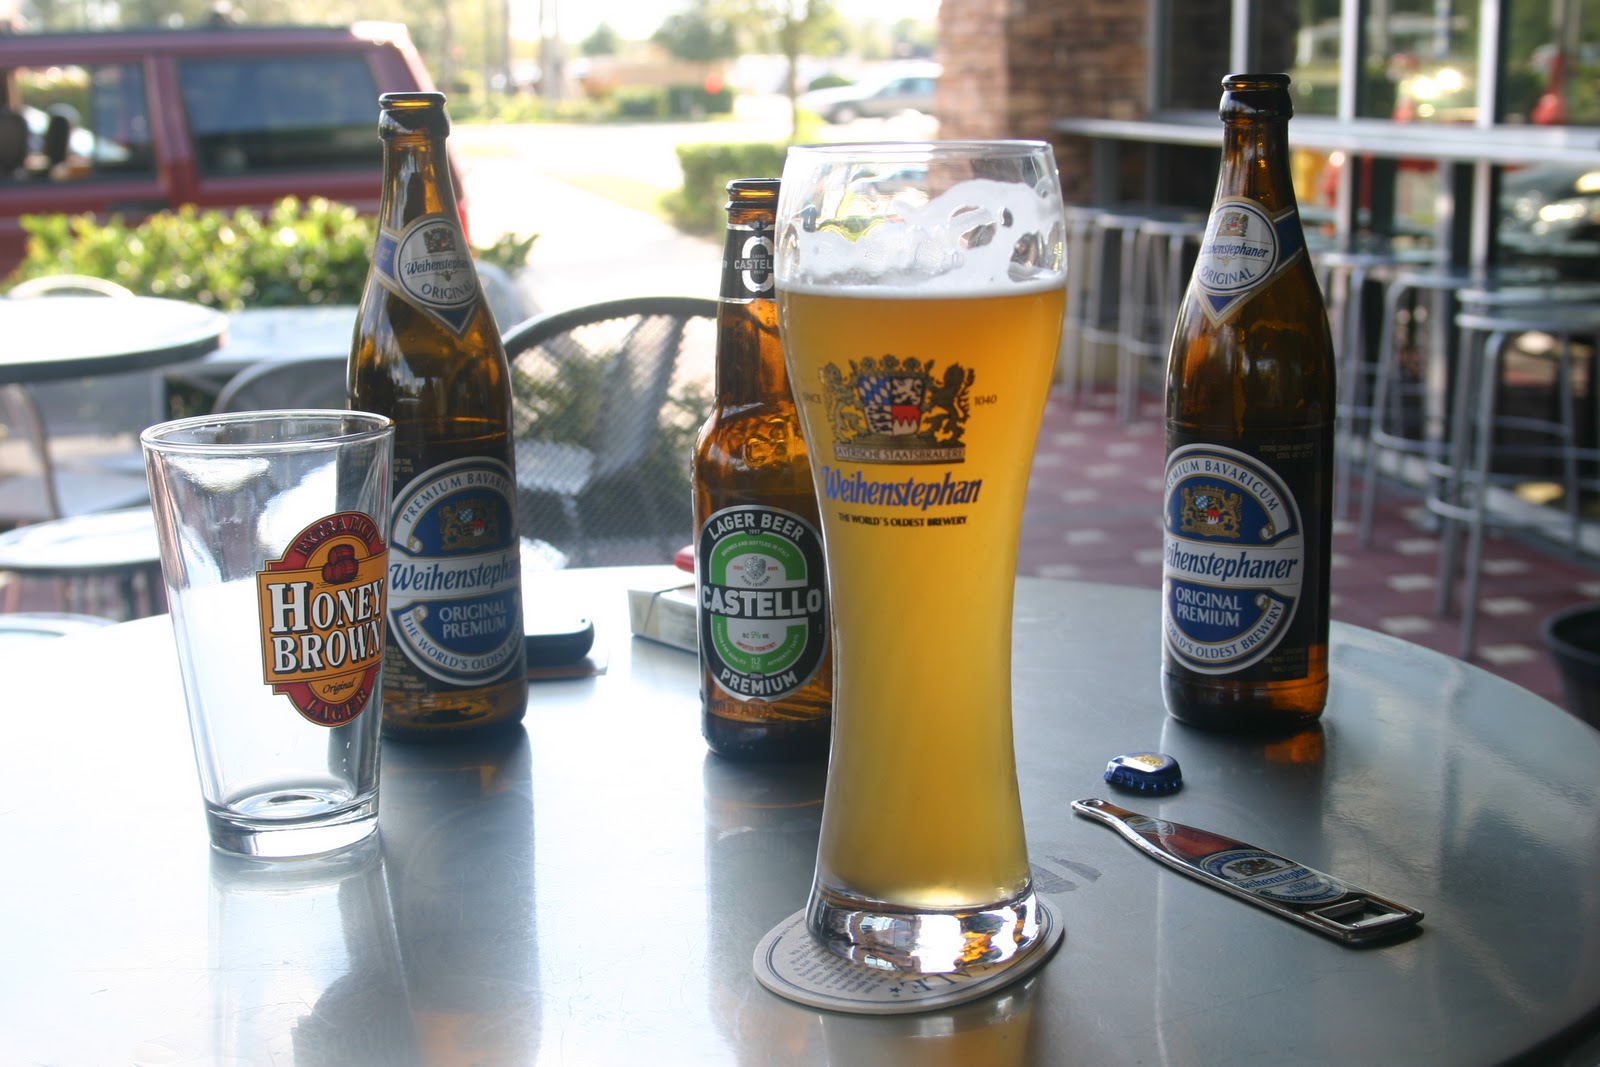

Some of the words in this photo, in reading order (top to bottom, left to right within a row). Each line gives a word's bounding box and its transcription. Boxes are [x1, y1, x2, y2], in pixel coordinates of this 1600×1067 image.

[734, 259, 773, 270] CASTEL
[1201, 265, 1256, 285] ORIGINAL
[421, 280, 474, 300] ORIGINAL
[402, 475, 463, 524] PREMIUM
[821, 465, 983, 511] Weihenstephan
[1205, 461, 1280, 511] BAVARICUM
[296, 516, 348, 557] EXTRA
[350, 515, 376, 544] RICH
[708, 513, 756, 541] LAGER
[760, 513, 805, 542] BEER
[891, 516, 926, 527] OLDEST
[927, 515, 968, 527] BREWERY
[390, 555, 517, 591] Weihenstepha
[1167, 541, 1298, 582] eihenstephaner
[267, 578, 385, 635] HONEY
[439, 599, 508, 623] ORIGINAL
[701, 585, 823, 618] CASTELLO
[1175, 586, 1243, 611] ORIGINAL
[442, 615, 507, 640] PREMIUM
[1176, 605, 1240, 628] PREMIUM
[1195, 644, 1239, 659] OLDEST
[1241, 604, 1283, 650] BREWERY
[271, 617, 384, 674] BROWN
[402, 615, 419, 638] THE
[418, 635, 469, 671] WORLD'S
[322, 676, 357, 694] Original
[720, 667, 798, 694] PREMIUM
[305, 688, 367, 721] LAGER
